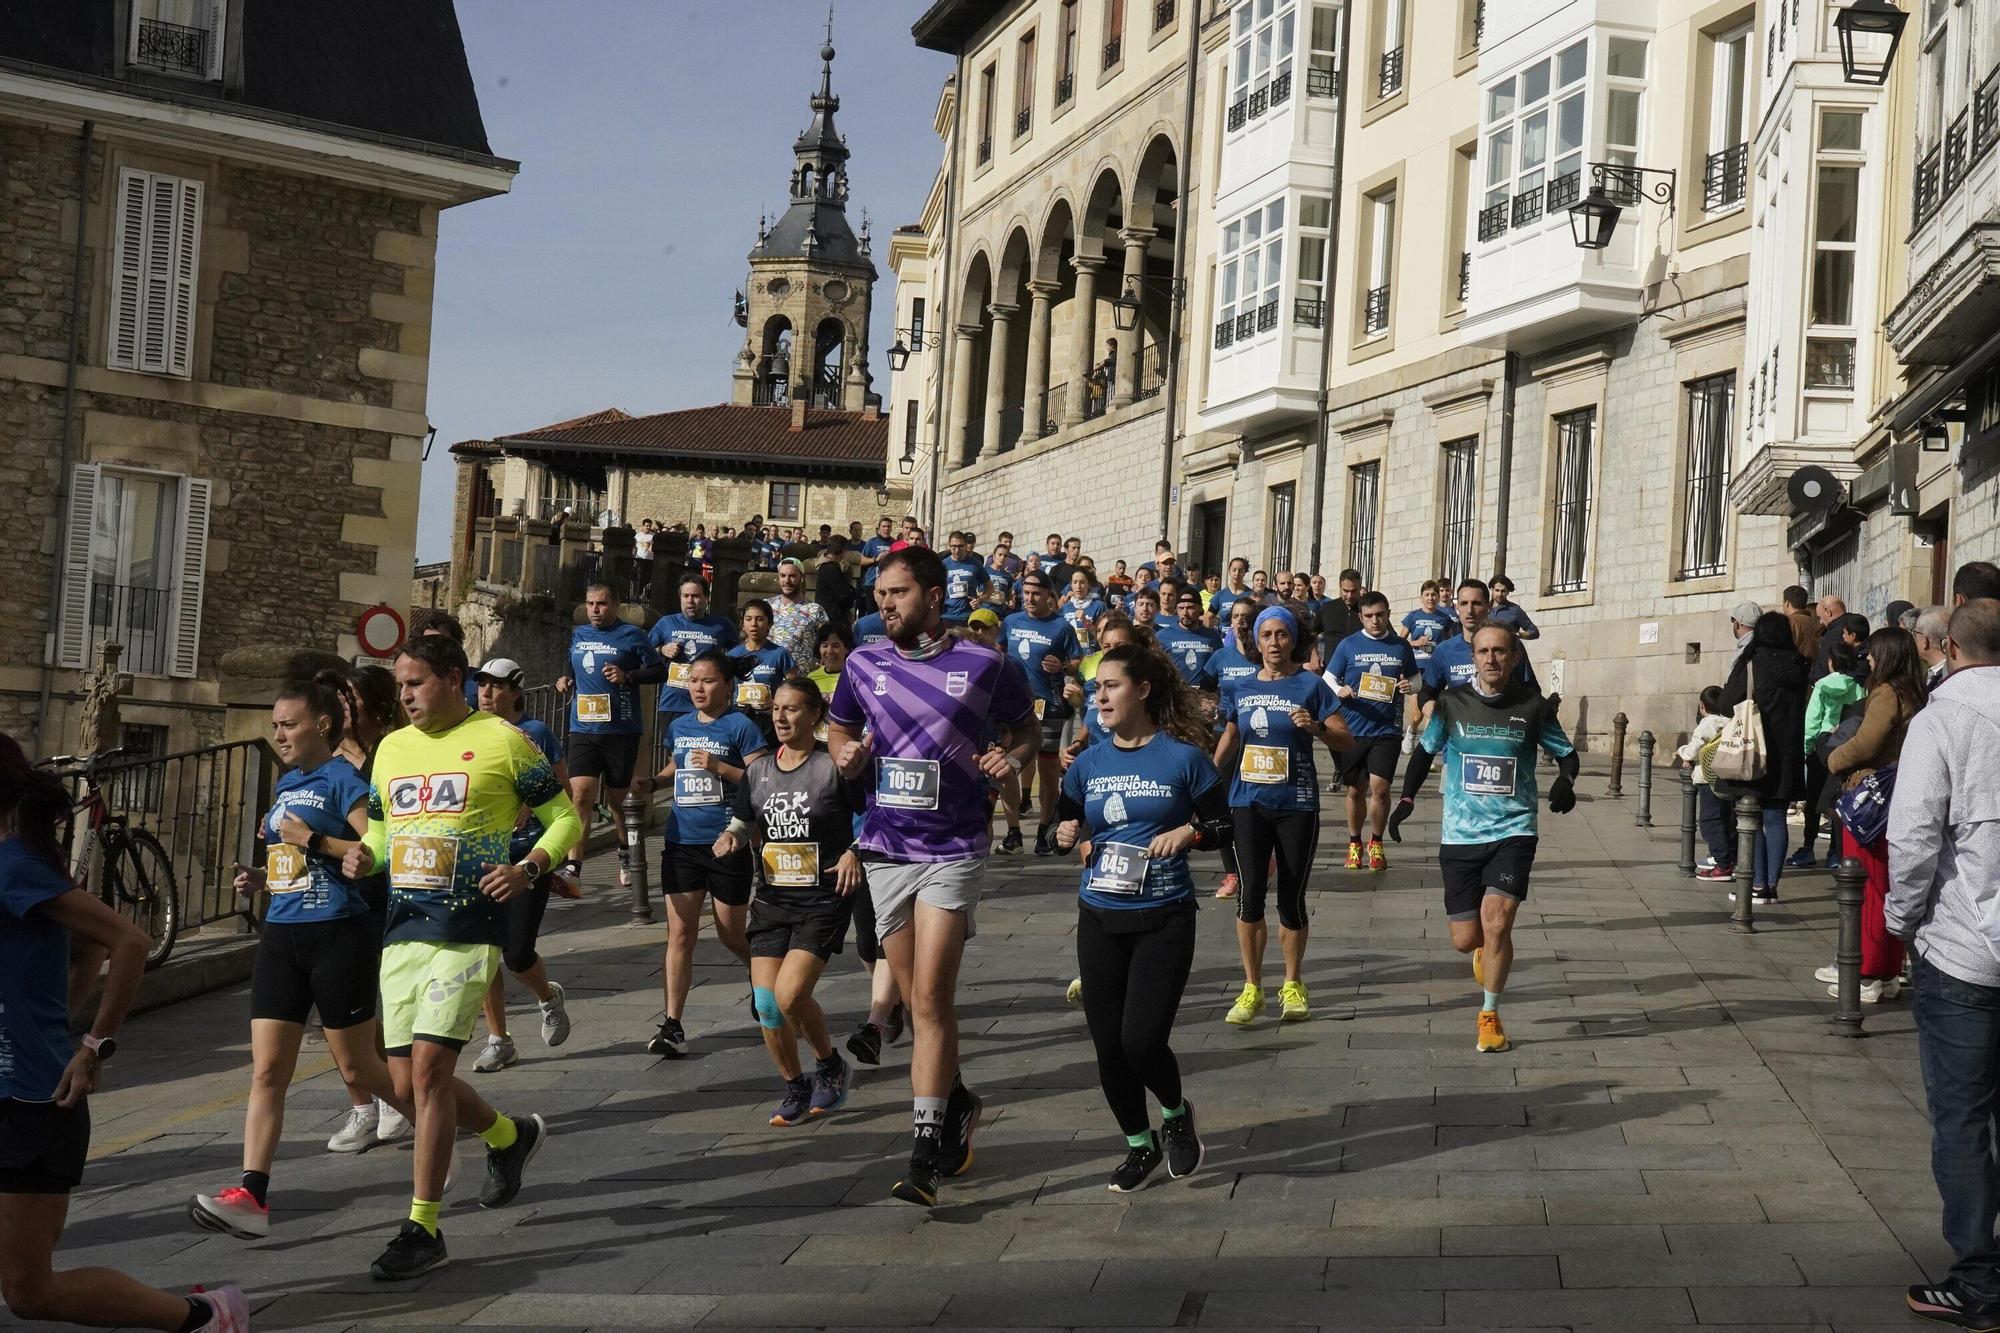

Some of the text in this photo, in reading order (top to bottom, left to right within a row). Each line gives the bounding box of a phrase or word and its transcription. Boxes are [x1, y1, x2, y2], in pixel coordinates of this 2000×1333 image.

[1921, 535, 1928, 547] 2
[1243, 694, 1279, 702] CONQUISTA
[1243, 699, 1292, 708] ALMENDRA
[1466, 722, 1526, 739] bertako
[676, 741, 720, 750] ALMENDRA
[1252, 755, 1274, 770] 156
[888, 769, 926, 791] 1057
[1094, 774, 1141, 786] CONQUISTA
[1476, 765, 1502, 781] 746
[683, 777, 713, 793] 1033
[1094, 780, 1159, 794] ALMENDRA
[1125, 789, 1173, 798] KONKISTA
[762, 791, 789, 814] 45
[764, 811, 810, 826] VILLA DE
[276, 855, 294, 875] 321
[402, 847, 437, 869] 433
[775, 853, 802, 871] 166
[1100, 854, 1130, 875] 845
